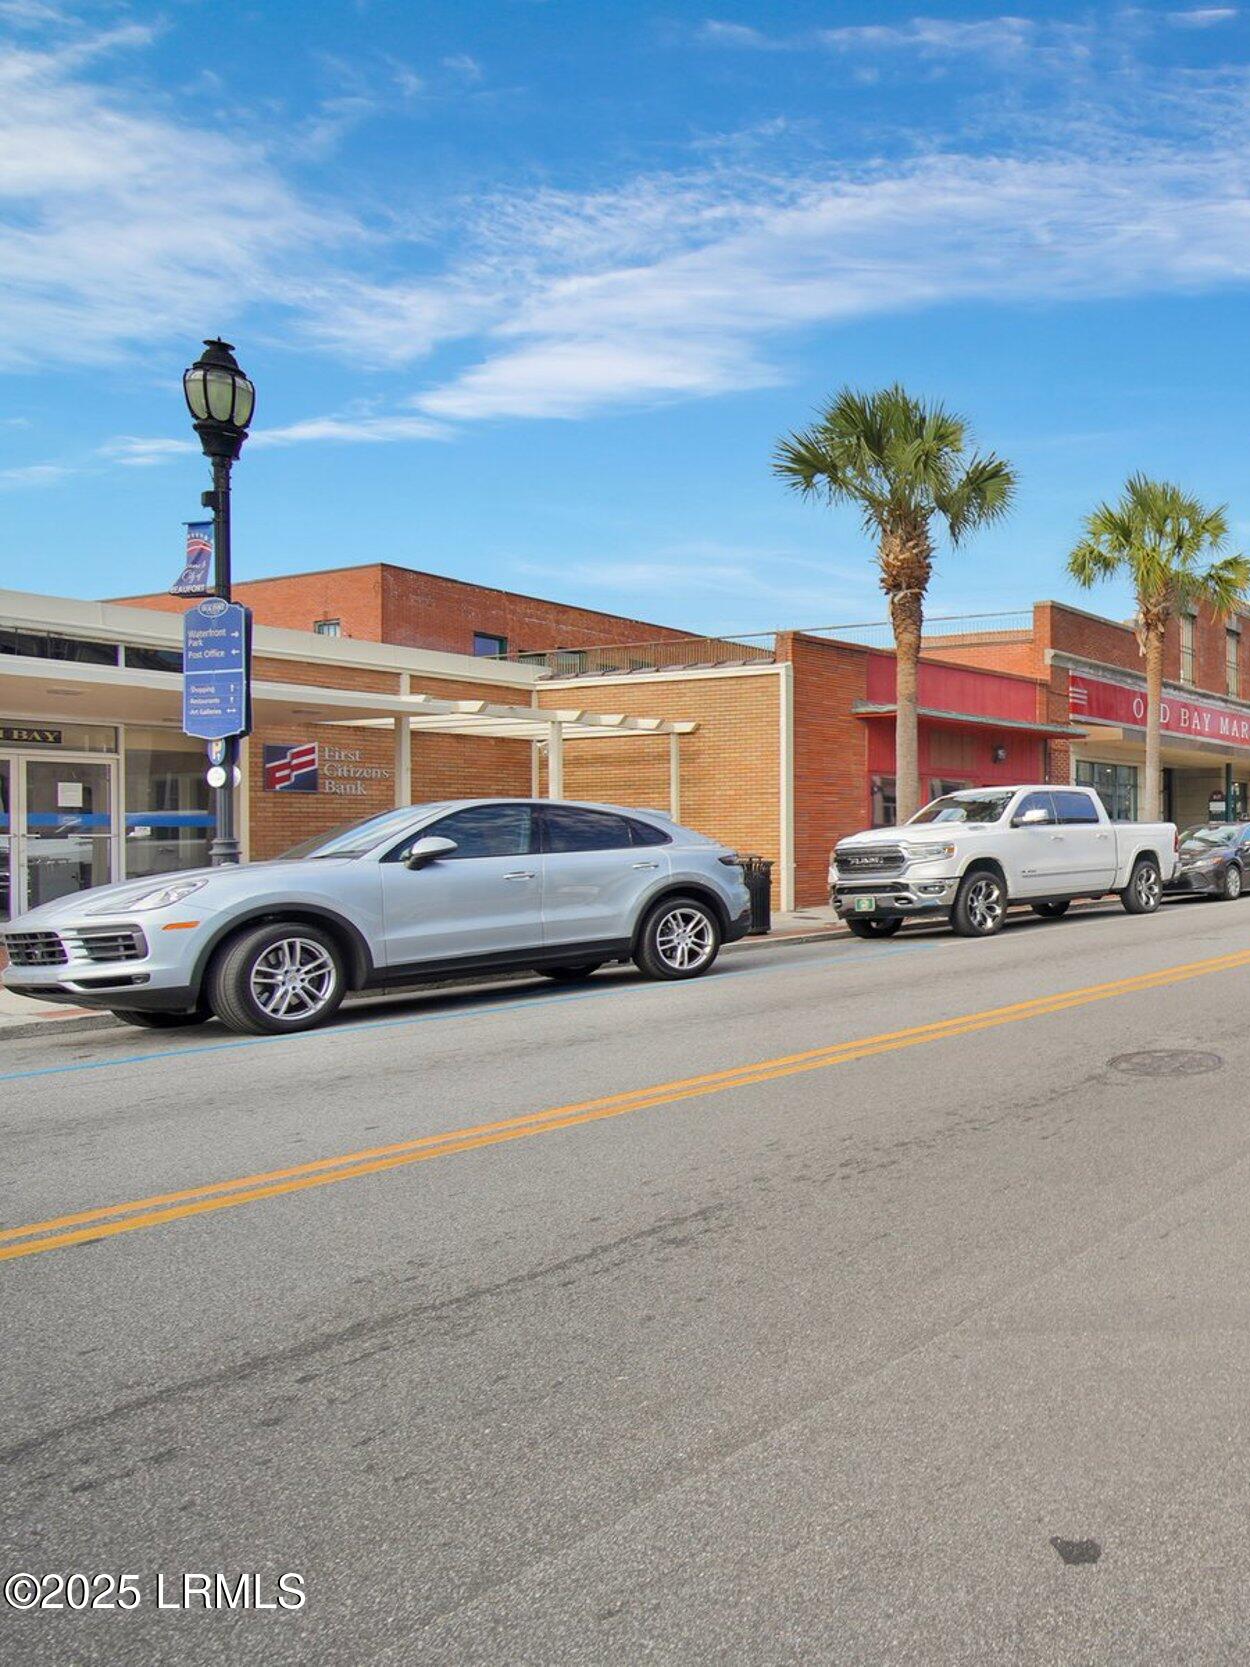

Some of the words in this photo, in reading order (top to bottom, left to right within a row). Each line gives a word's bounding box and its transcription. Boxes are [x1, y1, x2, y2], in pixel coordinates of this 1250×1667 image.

[1133, 698, 1170, 723] OD
[1180, 708, 1211, 731] BAY
[13, 730, 59, 742] BAY
[323, 746, 362, 761] First
[323, 763, 390, 779] Citizens
[323, 780, 367, 796] Bank
